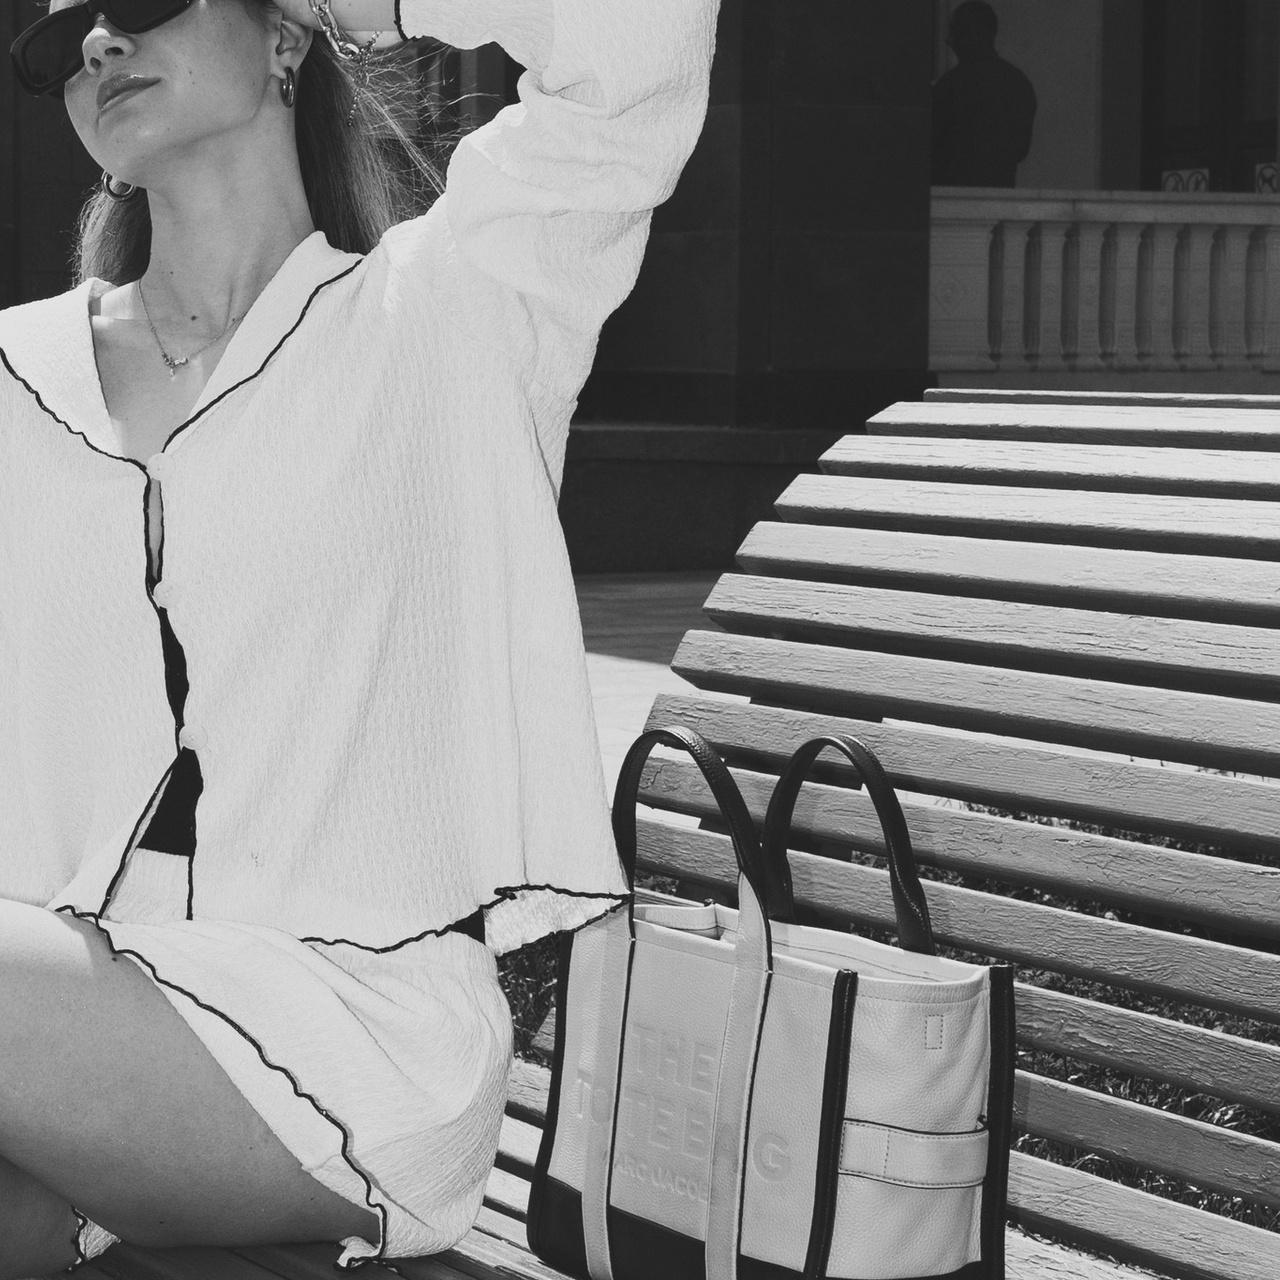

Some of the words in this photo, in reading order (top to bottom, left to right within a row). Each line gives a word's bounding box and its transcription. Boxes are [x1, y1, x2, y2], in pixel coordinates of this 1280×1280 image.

[631, 1023, 718, 1095] THE
[576, 1069, 674, 1150] TOTE
[603, 1150, 649, 1182] ARC
[650, 1164, 711, 1205] JACOB
